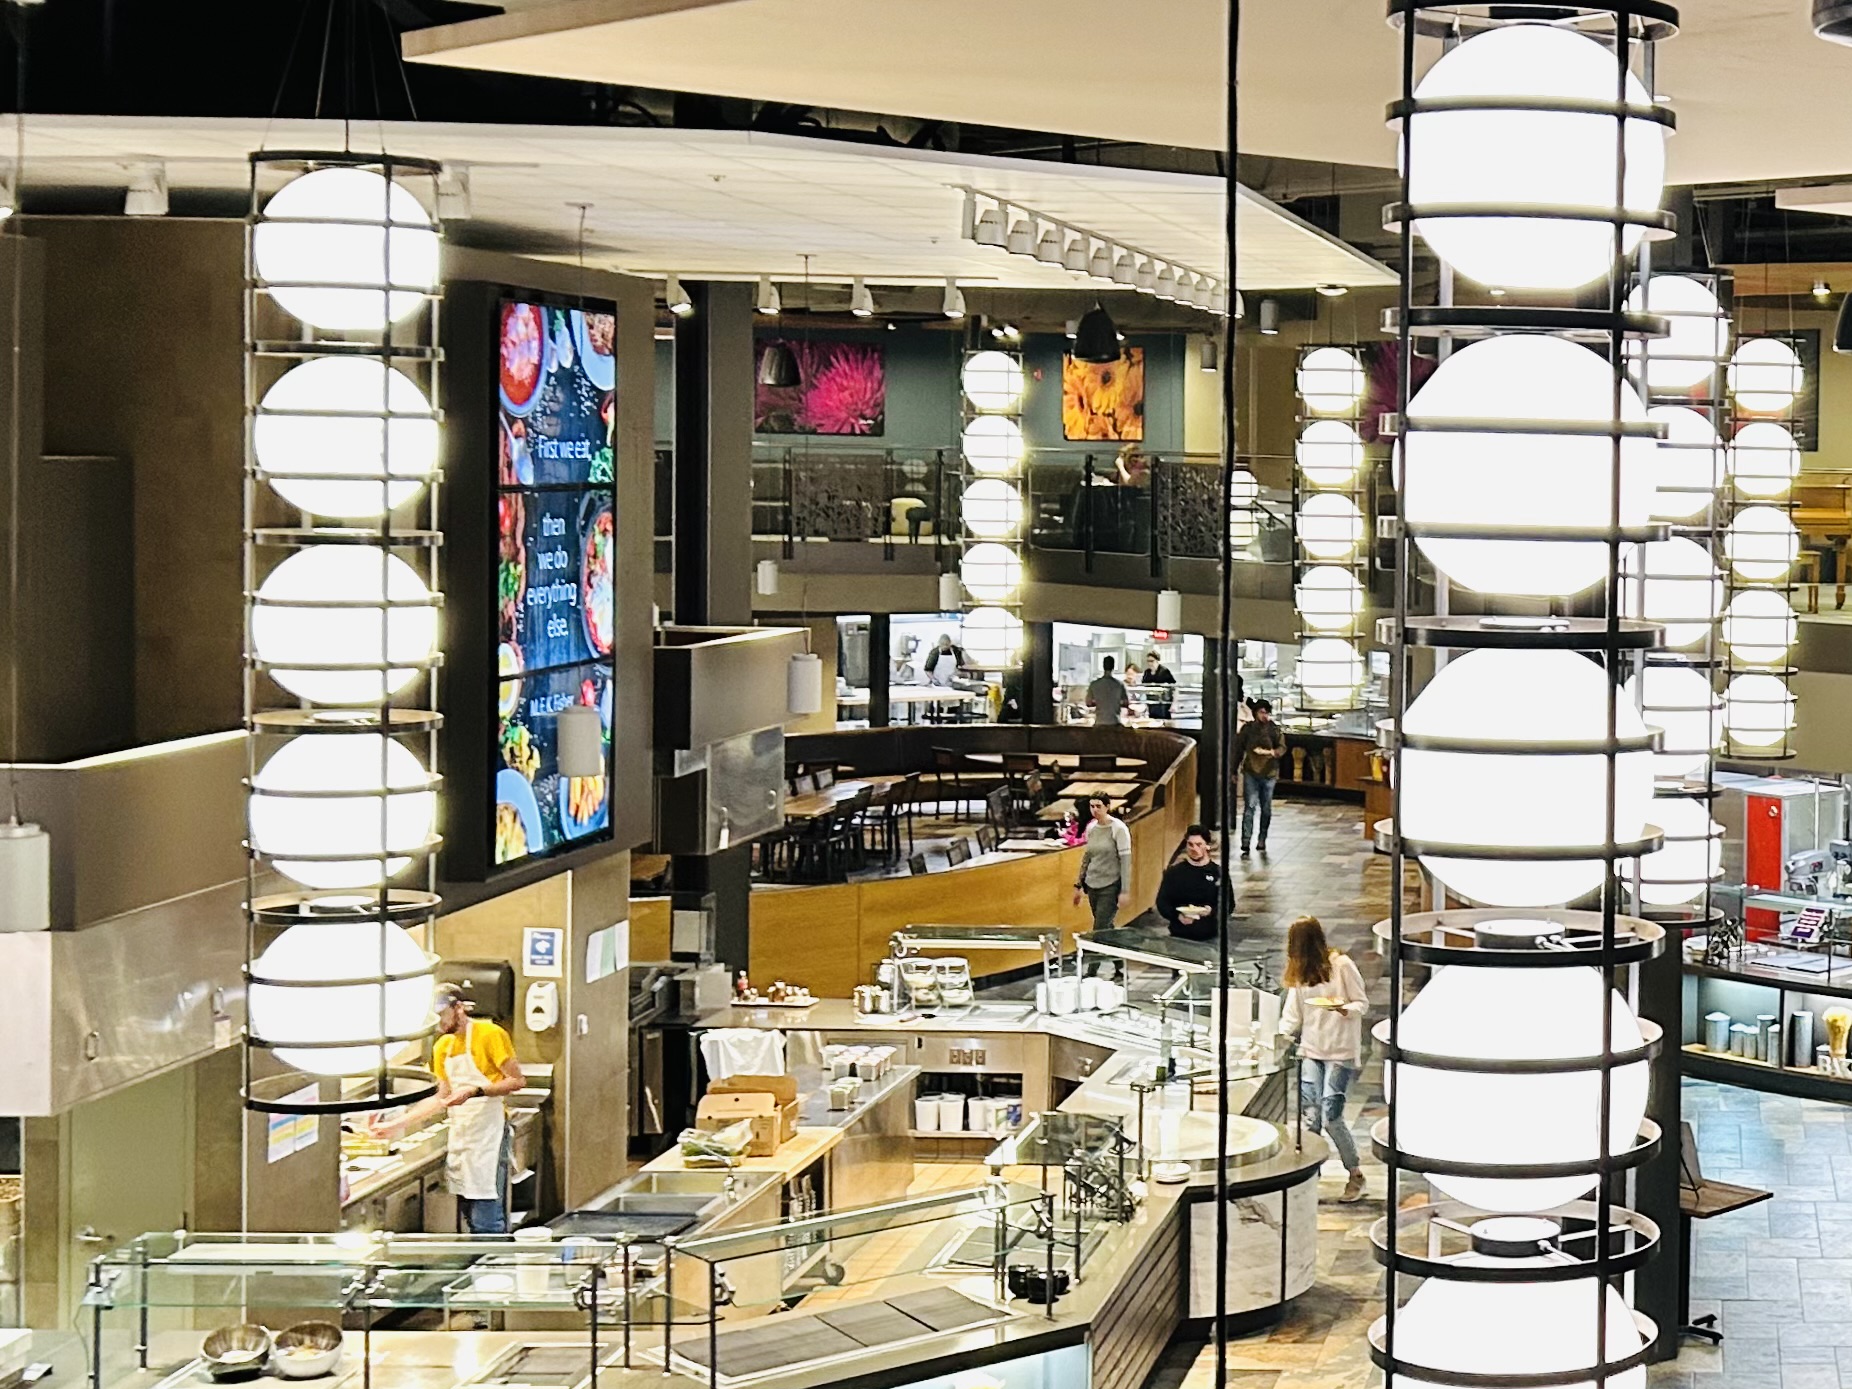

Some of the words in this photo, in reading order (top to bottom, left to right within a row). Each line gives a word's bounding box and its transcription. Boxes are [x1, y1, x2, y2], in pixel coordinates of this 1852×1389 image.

[538, 434, 559, 459] First
[560, 441, 574, 459] we
[542, 512, 566, 536] then
[537, 551, 553, 569] we
[554, 544, 568, 569] do
[526, 578, 577, 609] everything
